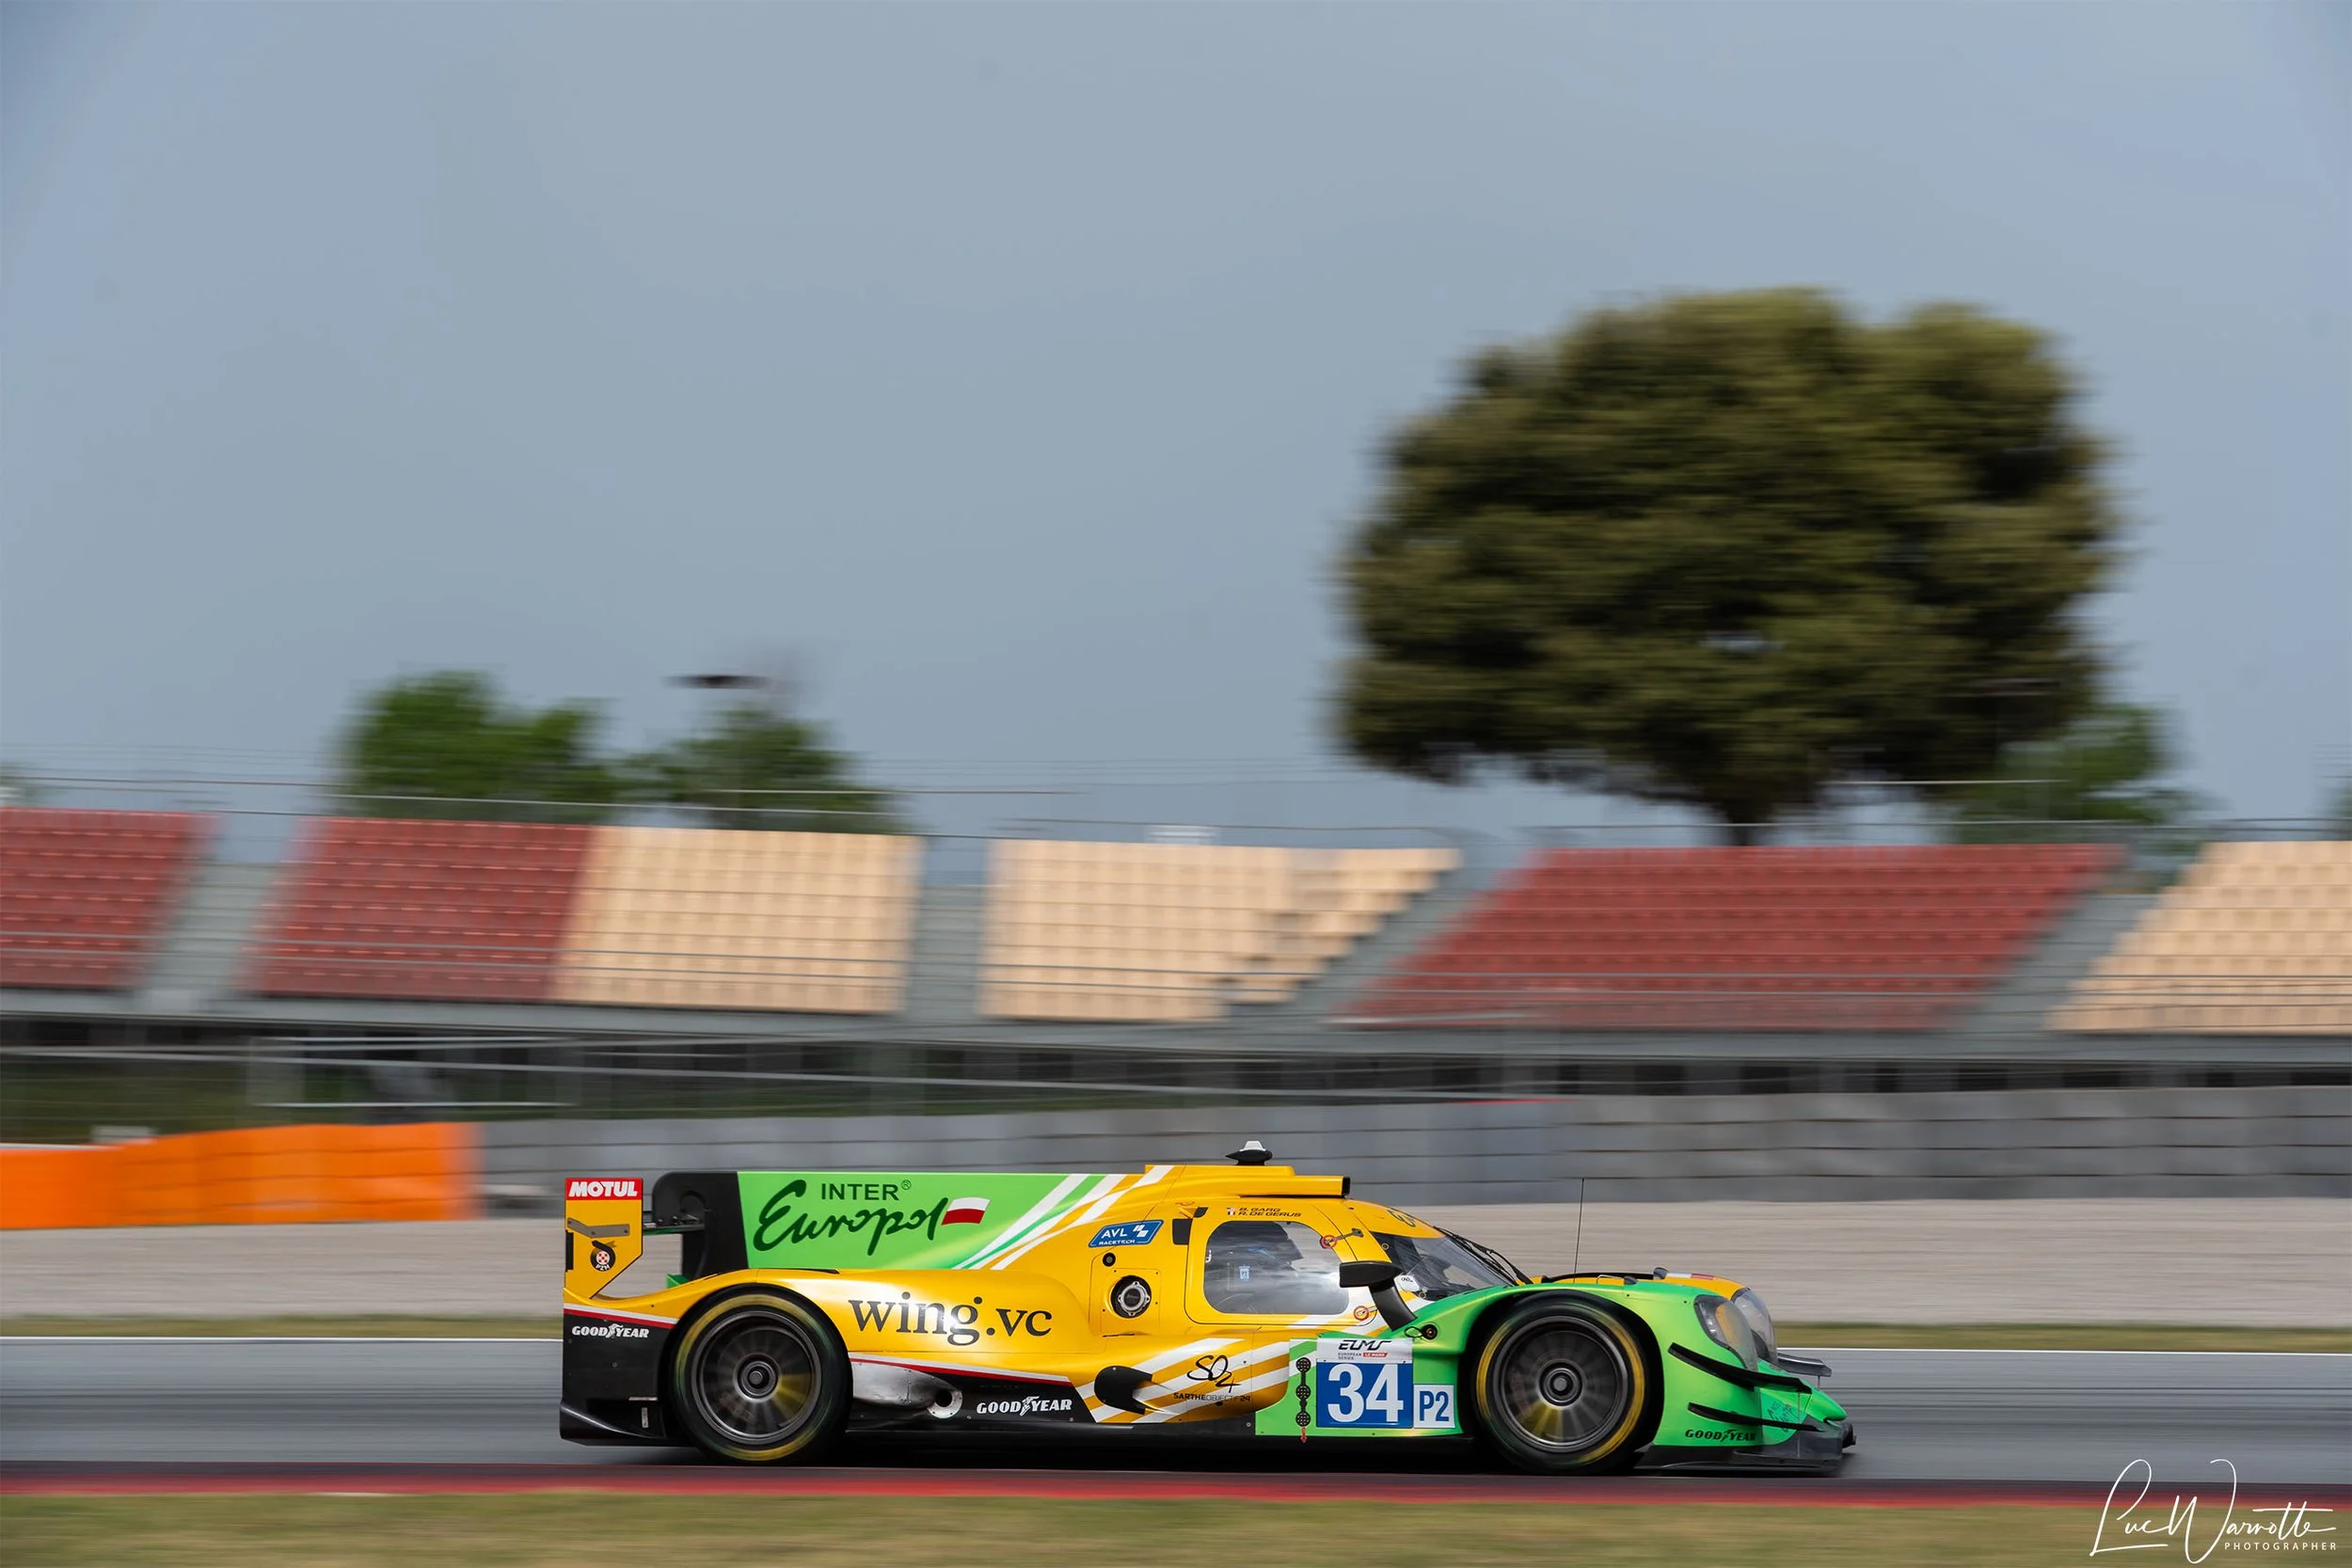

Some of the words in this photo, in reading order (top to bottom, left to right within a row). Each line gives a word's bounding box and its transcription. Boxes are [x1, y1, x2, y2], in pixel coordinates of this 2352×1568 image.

[568, 1181, 637, 1197] MOTUL
[754, 1179, 948, 1256] Europol
[1101, 1228, 1128, 1239] AVL
[848, 1291, 1053, 1346] wing.vc
[976, 1396, 1073, 1417] GOODYEAR
[1327, 1364, 1405, 1423] 34
[1419, 1390, 1450, 1422] P2
